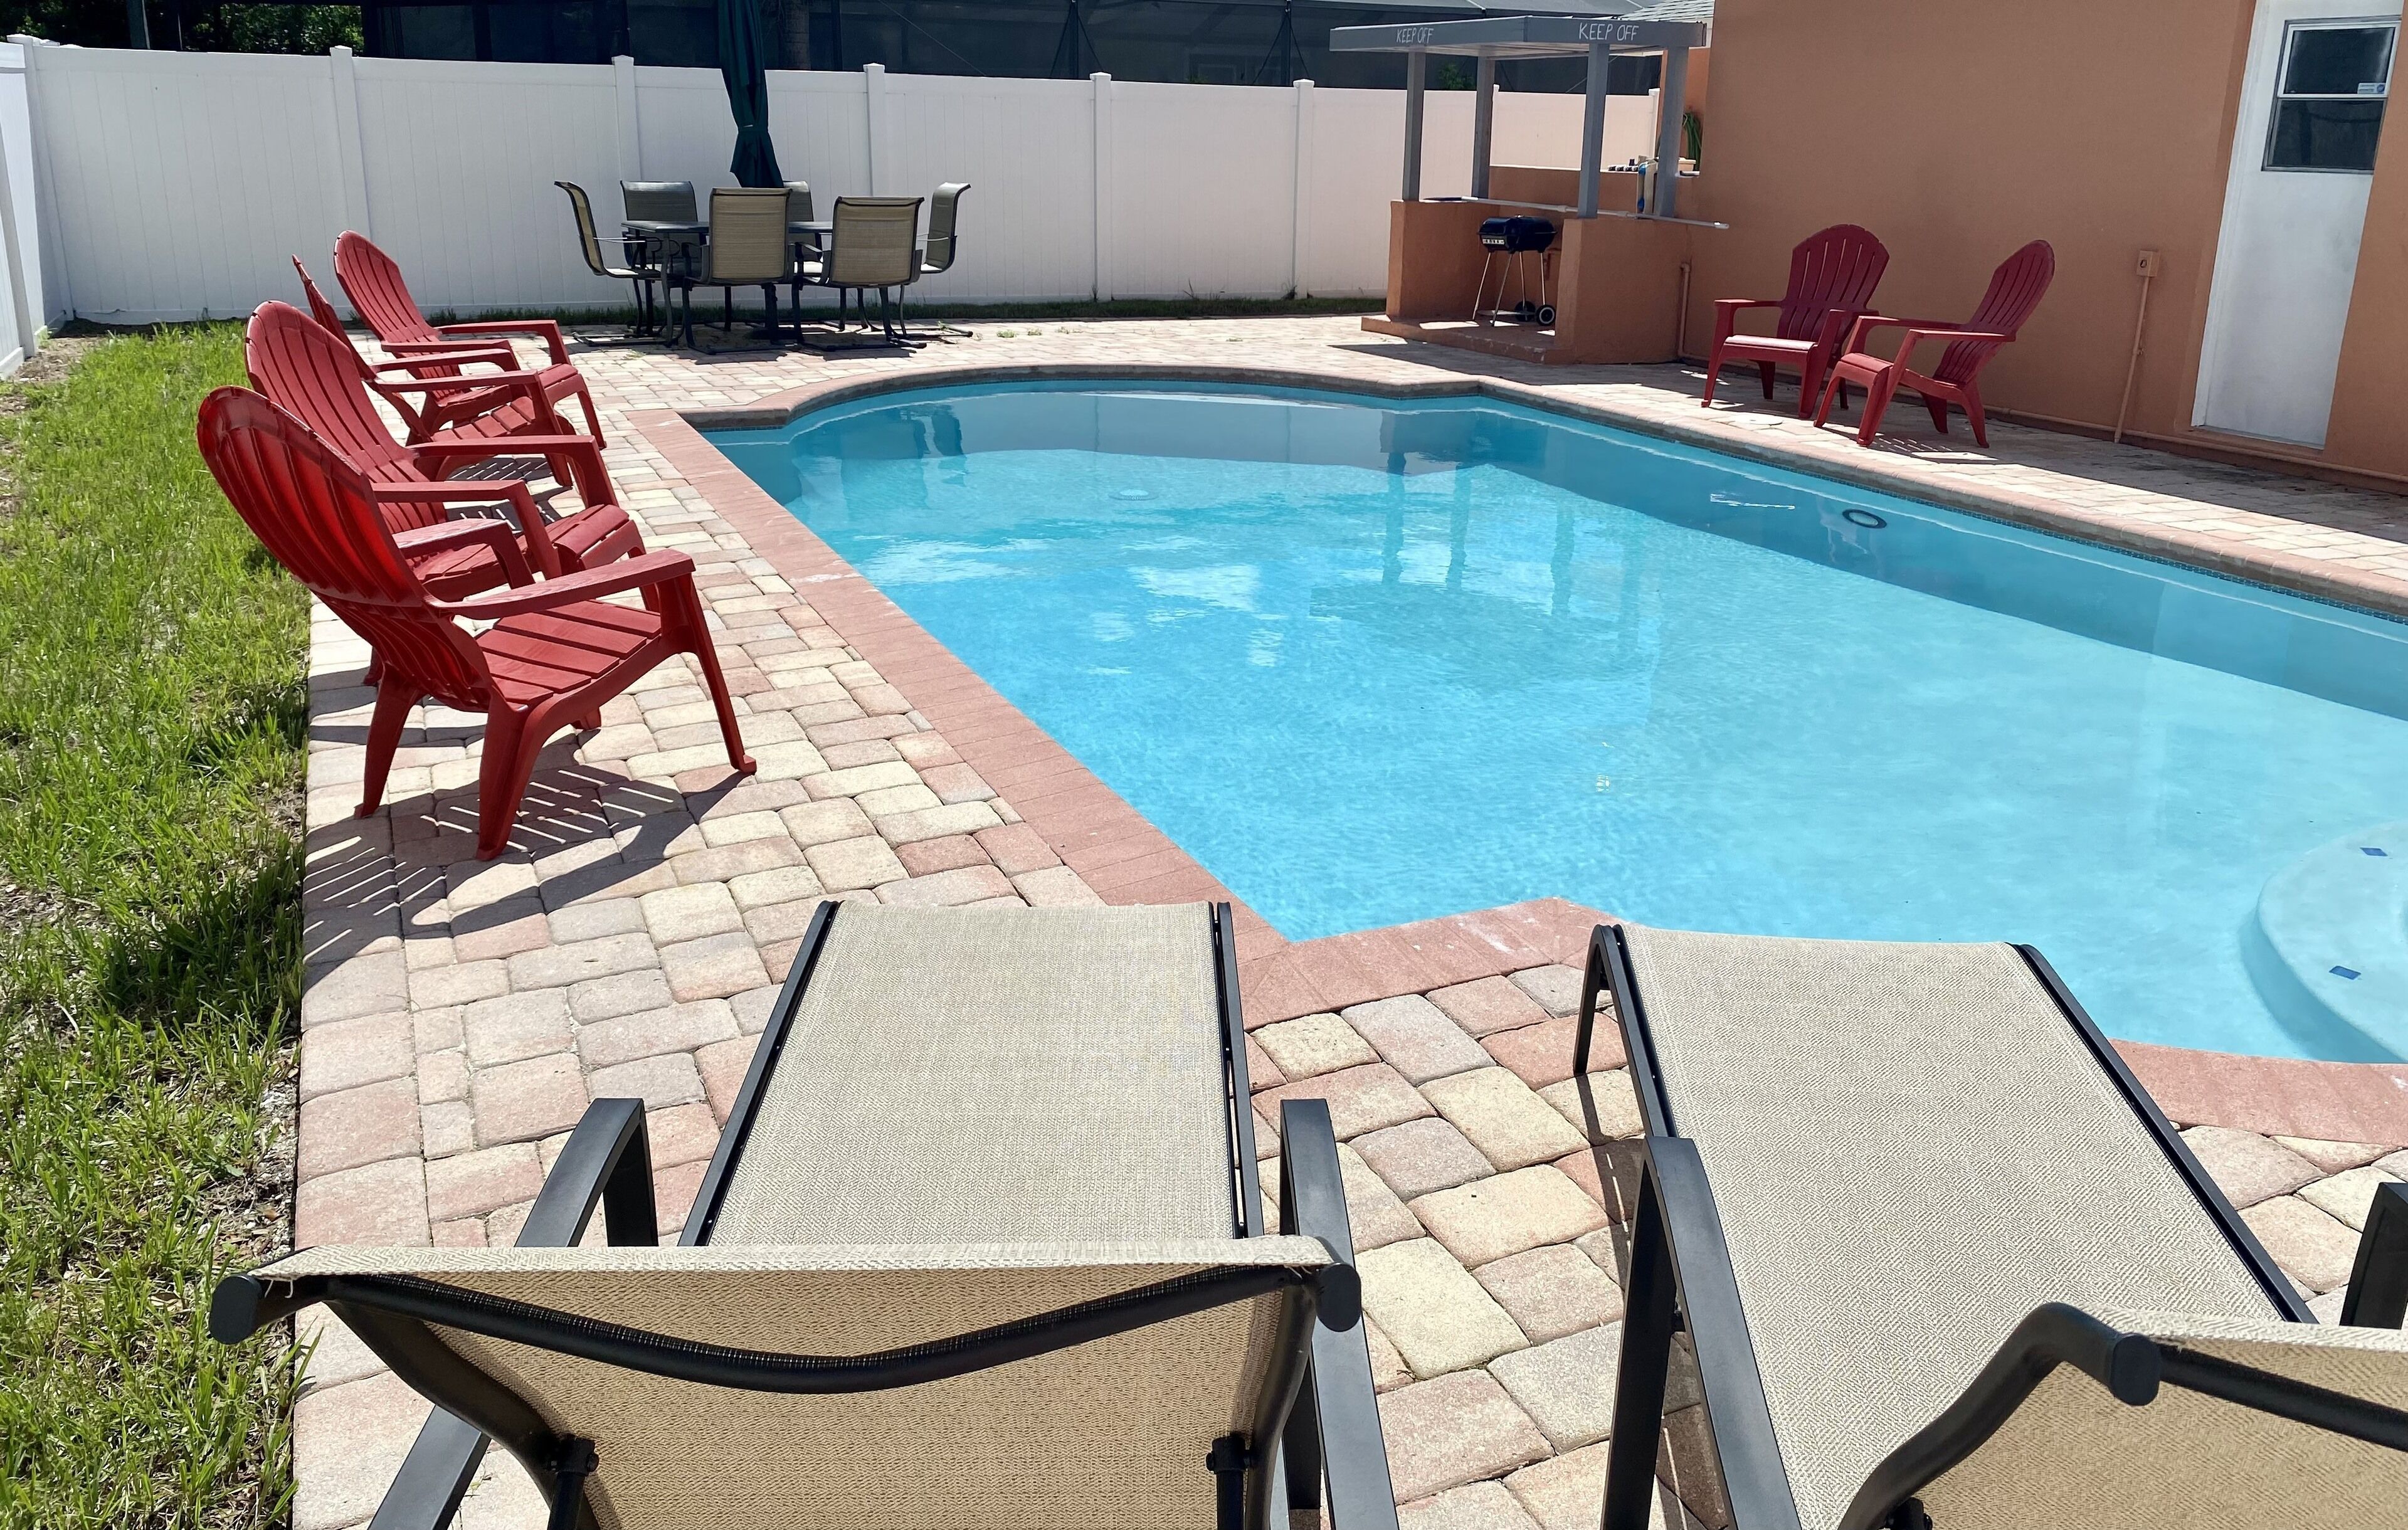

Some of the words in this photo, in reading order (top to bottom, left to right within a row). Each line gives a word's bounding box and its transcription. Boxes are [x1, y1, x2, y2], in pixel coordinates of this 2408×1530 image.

[1397, 28, 1417, 43] KEEP
[1417, 27, 1434, 44] OFF
[1579, 23, 1613, 40] KEEP
[1617, 24, 1639, 41] OFF
